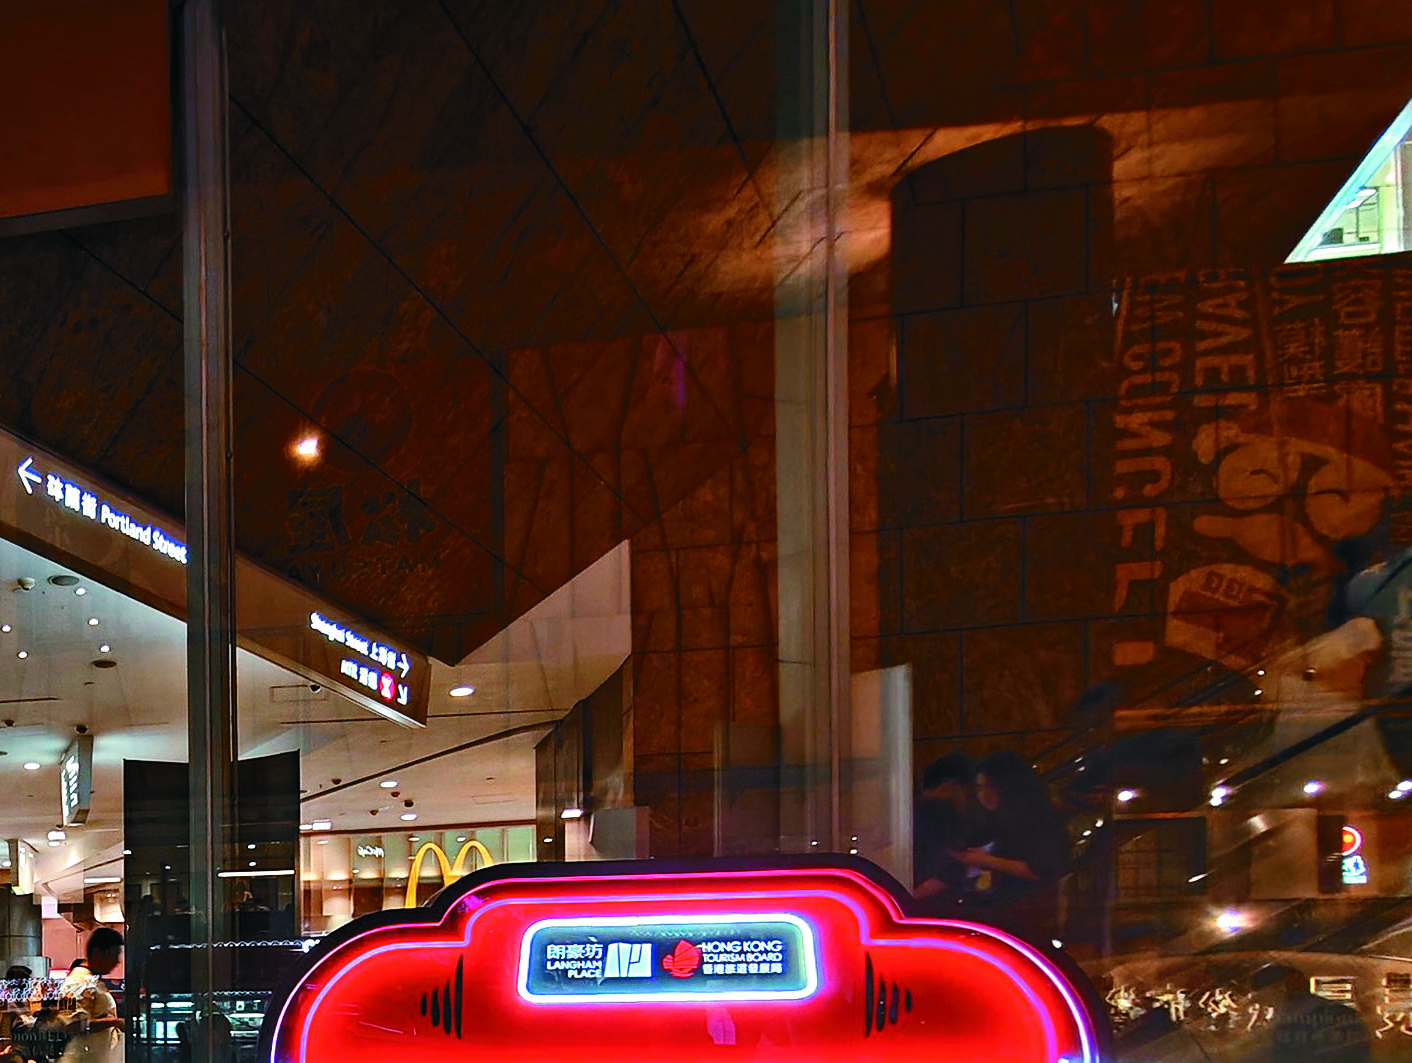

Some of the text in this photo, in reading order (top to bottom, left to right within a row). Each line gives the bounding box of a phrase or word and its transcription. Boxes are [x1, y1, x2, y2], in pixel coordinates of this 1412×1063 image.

[100, 502, 152, 546] Portland
[152, 528, 188, 565] Street
[703, 941, 782, 952] HONG KONG
[546, 944, 603, 960] 朗豪坊
[703, 953, 782, 962] TOURISM BOARD
[546, 961, 602, 969] LANGHAM
[568, 969, 602, 978] PLACE
